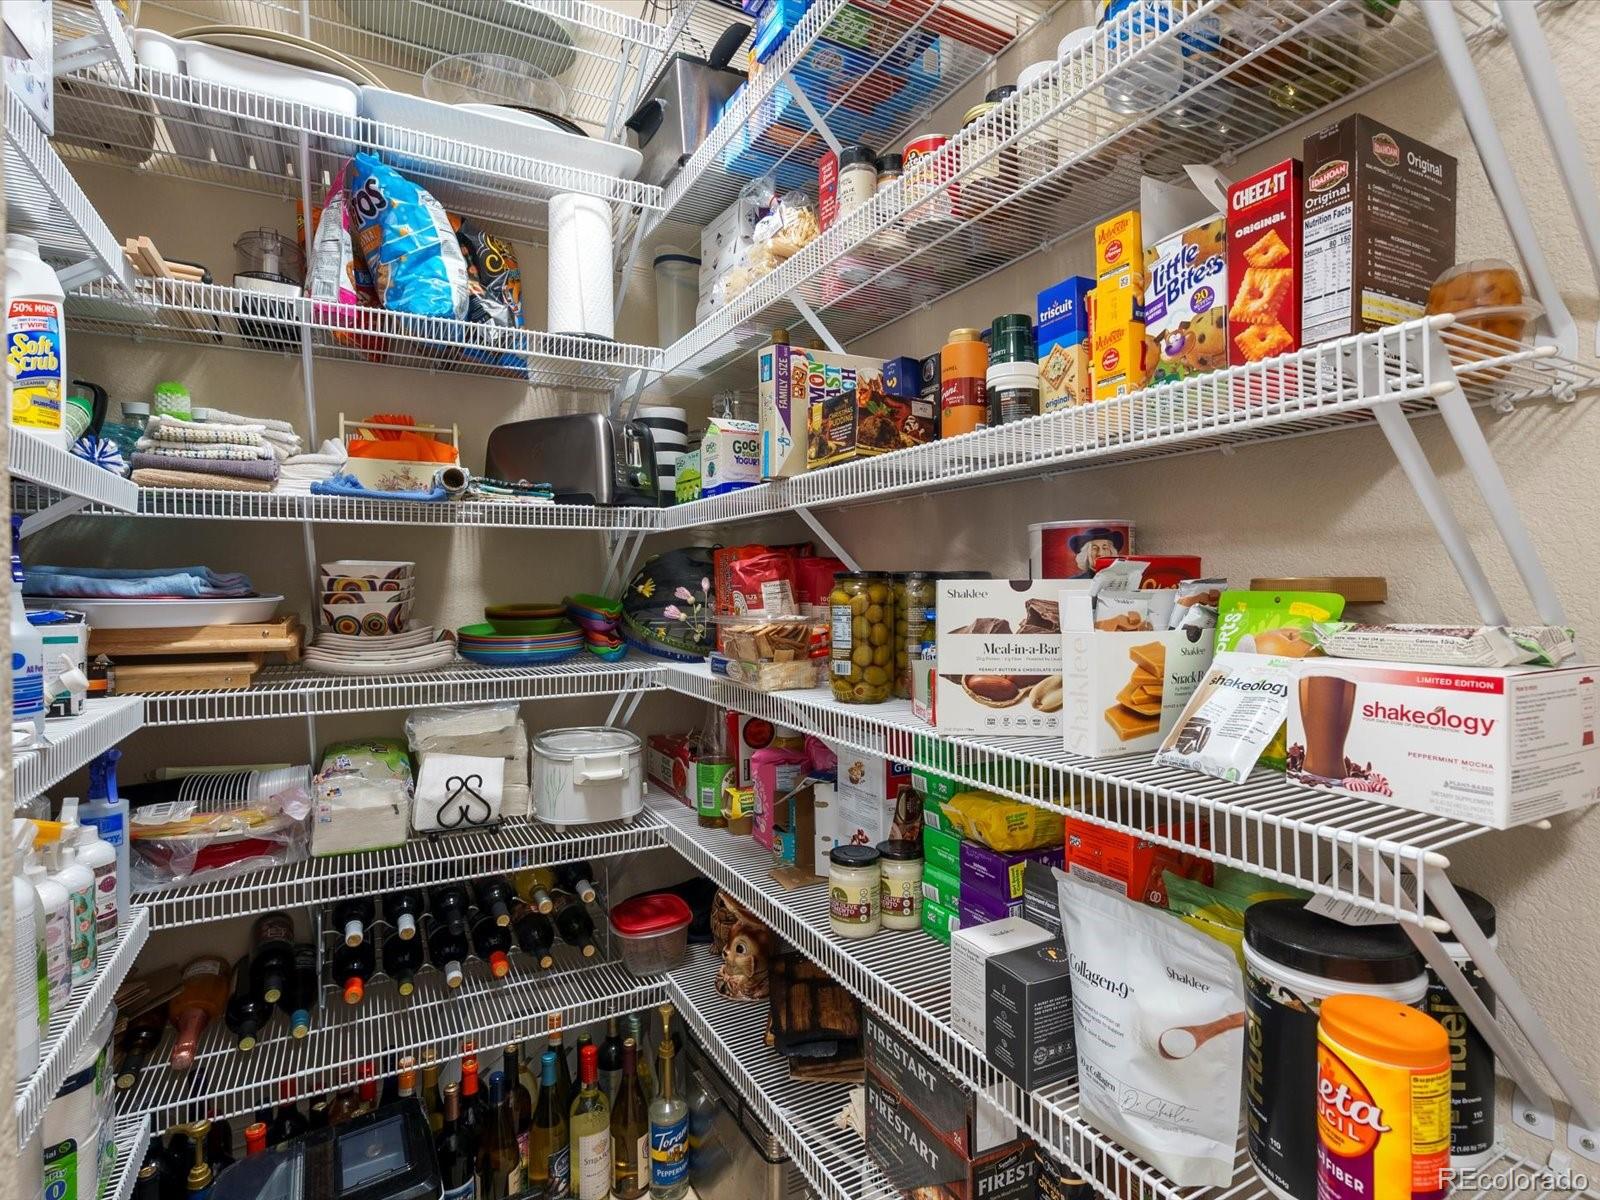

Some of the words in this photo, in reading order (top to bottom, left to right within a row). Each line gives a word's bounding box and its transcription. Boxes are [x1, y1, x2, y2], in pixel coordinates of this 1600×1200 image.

[1407, 152, 1443, 177] Original
[1305, 183, 1351, 209] Original
[1333, 206, 1352, 219] Facts
[1152, 244, 1199, 297] Little
[1194, 288, 1208, 302] 20
[12, 302, 33, 313] 50%
[34, 304, 56, 314] MORE
[1040, 299, 1073, 323] triscuit
[12, 333, 53, 356] Soft
[7, 352, 59, 375] Scrub
[778, 357, 789, 376] SIZE
[778, 381, 788, 409] FAMILY
[1045, 393, 1070, 409] original
[947, 588, 989, 599] Shaklee
[984, 642, 1060, 655] Meal-in-a-Bar
[1416, 676, 1452, 687] LIMITED
[1454, 678, 1495, 690] EDITION
[1362, 701, 1495, 736] shakeology
[1408, 751, 1459, 764] PEPPERMINT
[1461, 760, 1494, 769] MOCHA
[1166, 966, 1210, 993] Shaklee
[867, 1018, 937, 1093] FIRESTART
[1318, 1062, 1392, 1133] eta
[869, 1088, 939, 1171] FIRESTART
[1318, 1106, 1361, 1142] UCIL
[978, 1161, 1036, 1196] FIREST
[1325, 1157, 1364, 1194] FIBER
